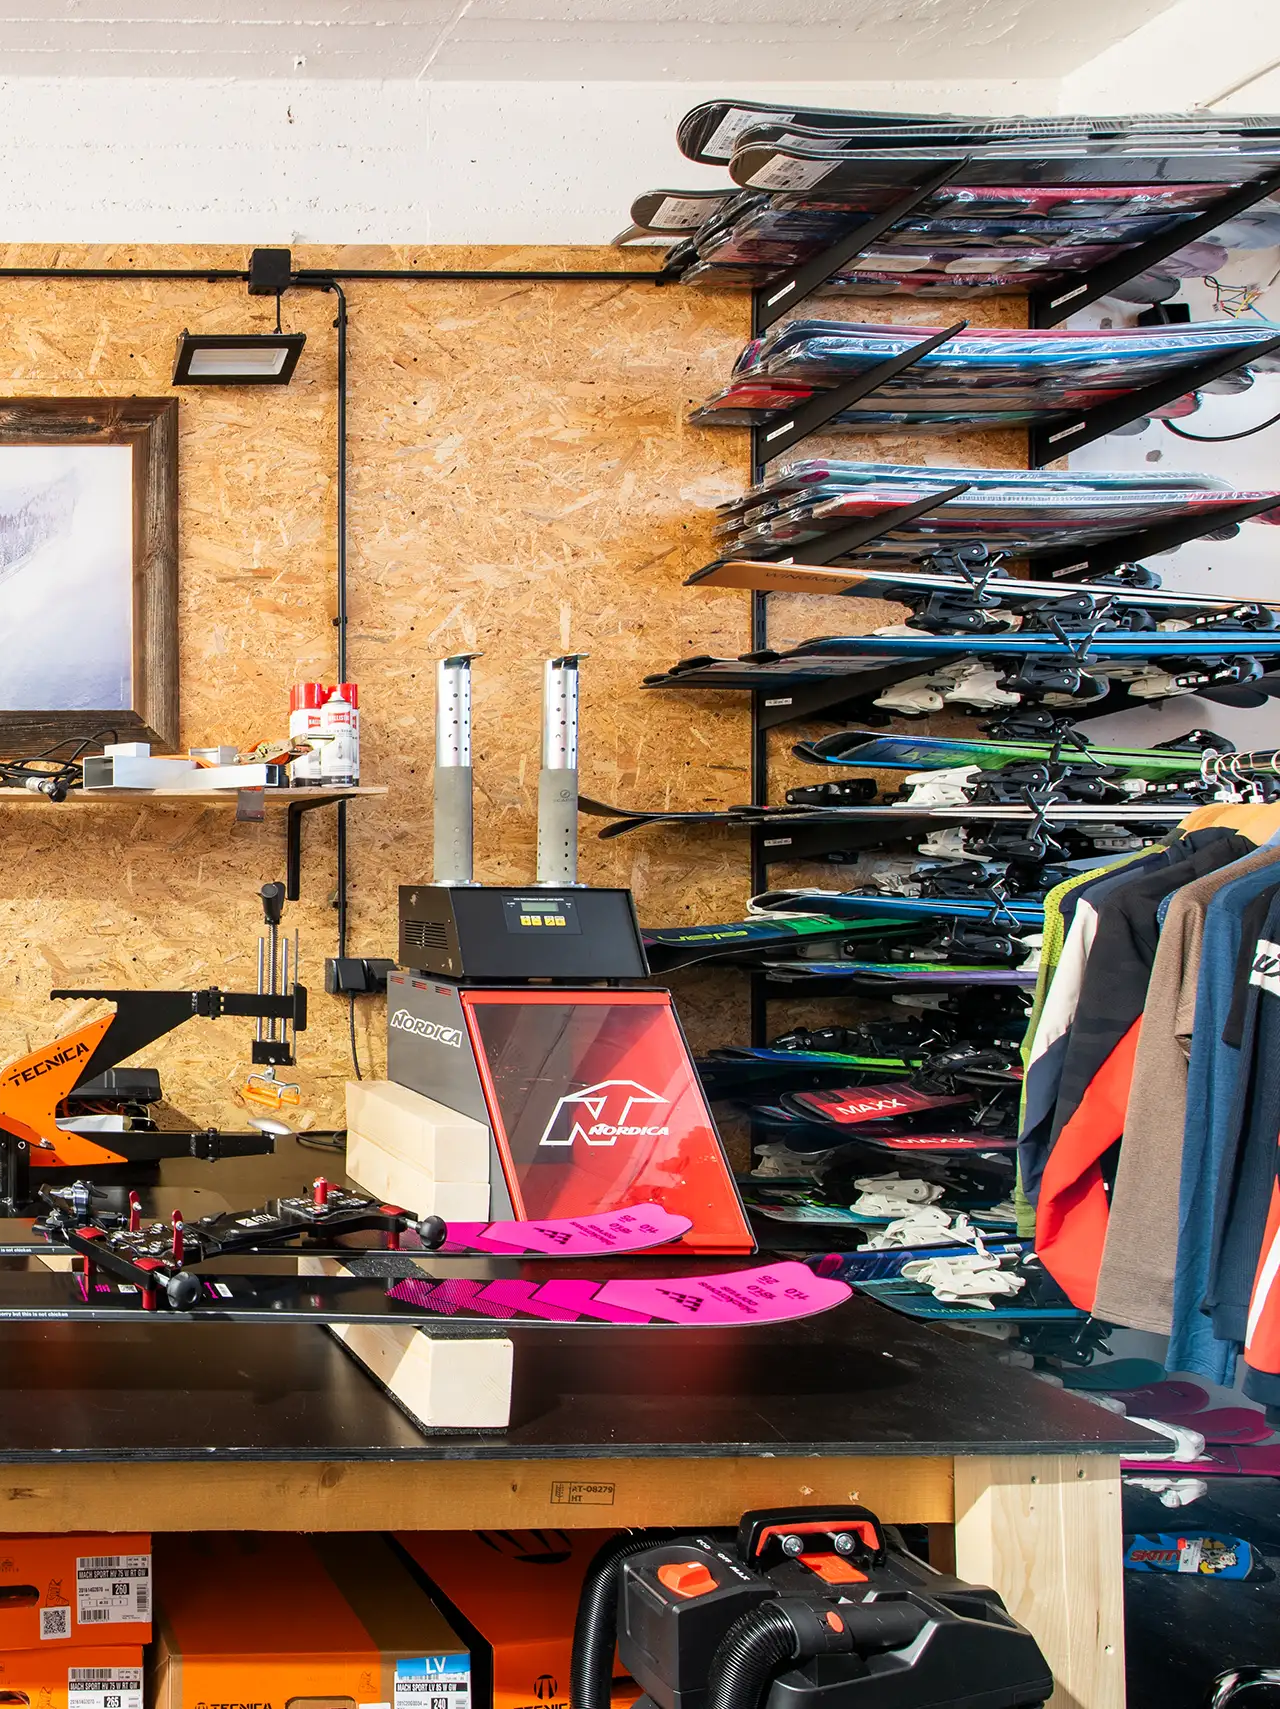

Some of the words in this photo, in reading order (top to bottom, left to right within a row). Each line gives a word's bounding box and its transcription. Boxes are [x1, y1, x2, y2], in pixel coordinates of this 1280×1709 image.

[390, 1009, 463, 1048] NORDICA
[8, 1042, 90, 1087] TECNICA
[836, 1098, 908, 1116] MAXX
[588, 1123, 669, 1136] NORDICA
[78, 1571, 93, 1579] MACH
[93, 1570, 110, 1579] SPORT
[729, 1566, 751, 1581] MAX
[115, 1584, 128, 1595] 260
[425, 1656, 447, 1674] LV
[70, 1682, 85, 1691] MACH
[85, 1682, 101, 1691] SPORT
[397, 1683, 412, 1692] MACH
[412, 1683, 428, 1692] SPORT
[428, 1683, 435, 1692] LV
[106, 1696, 120, 1708] 265
[433, 1698, 447, 1709] 240
